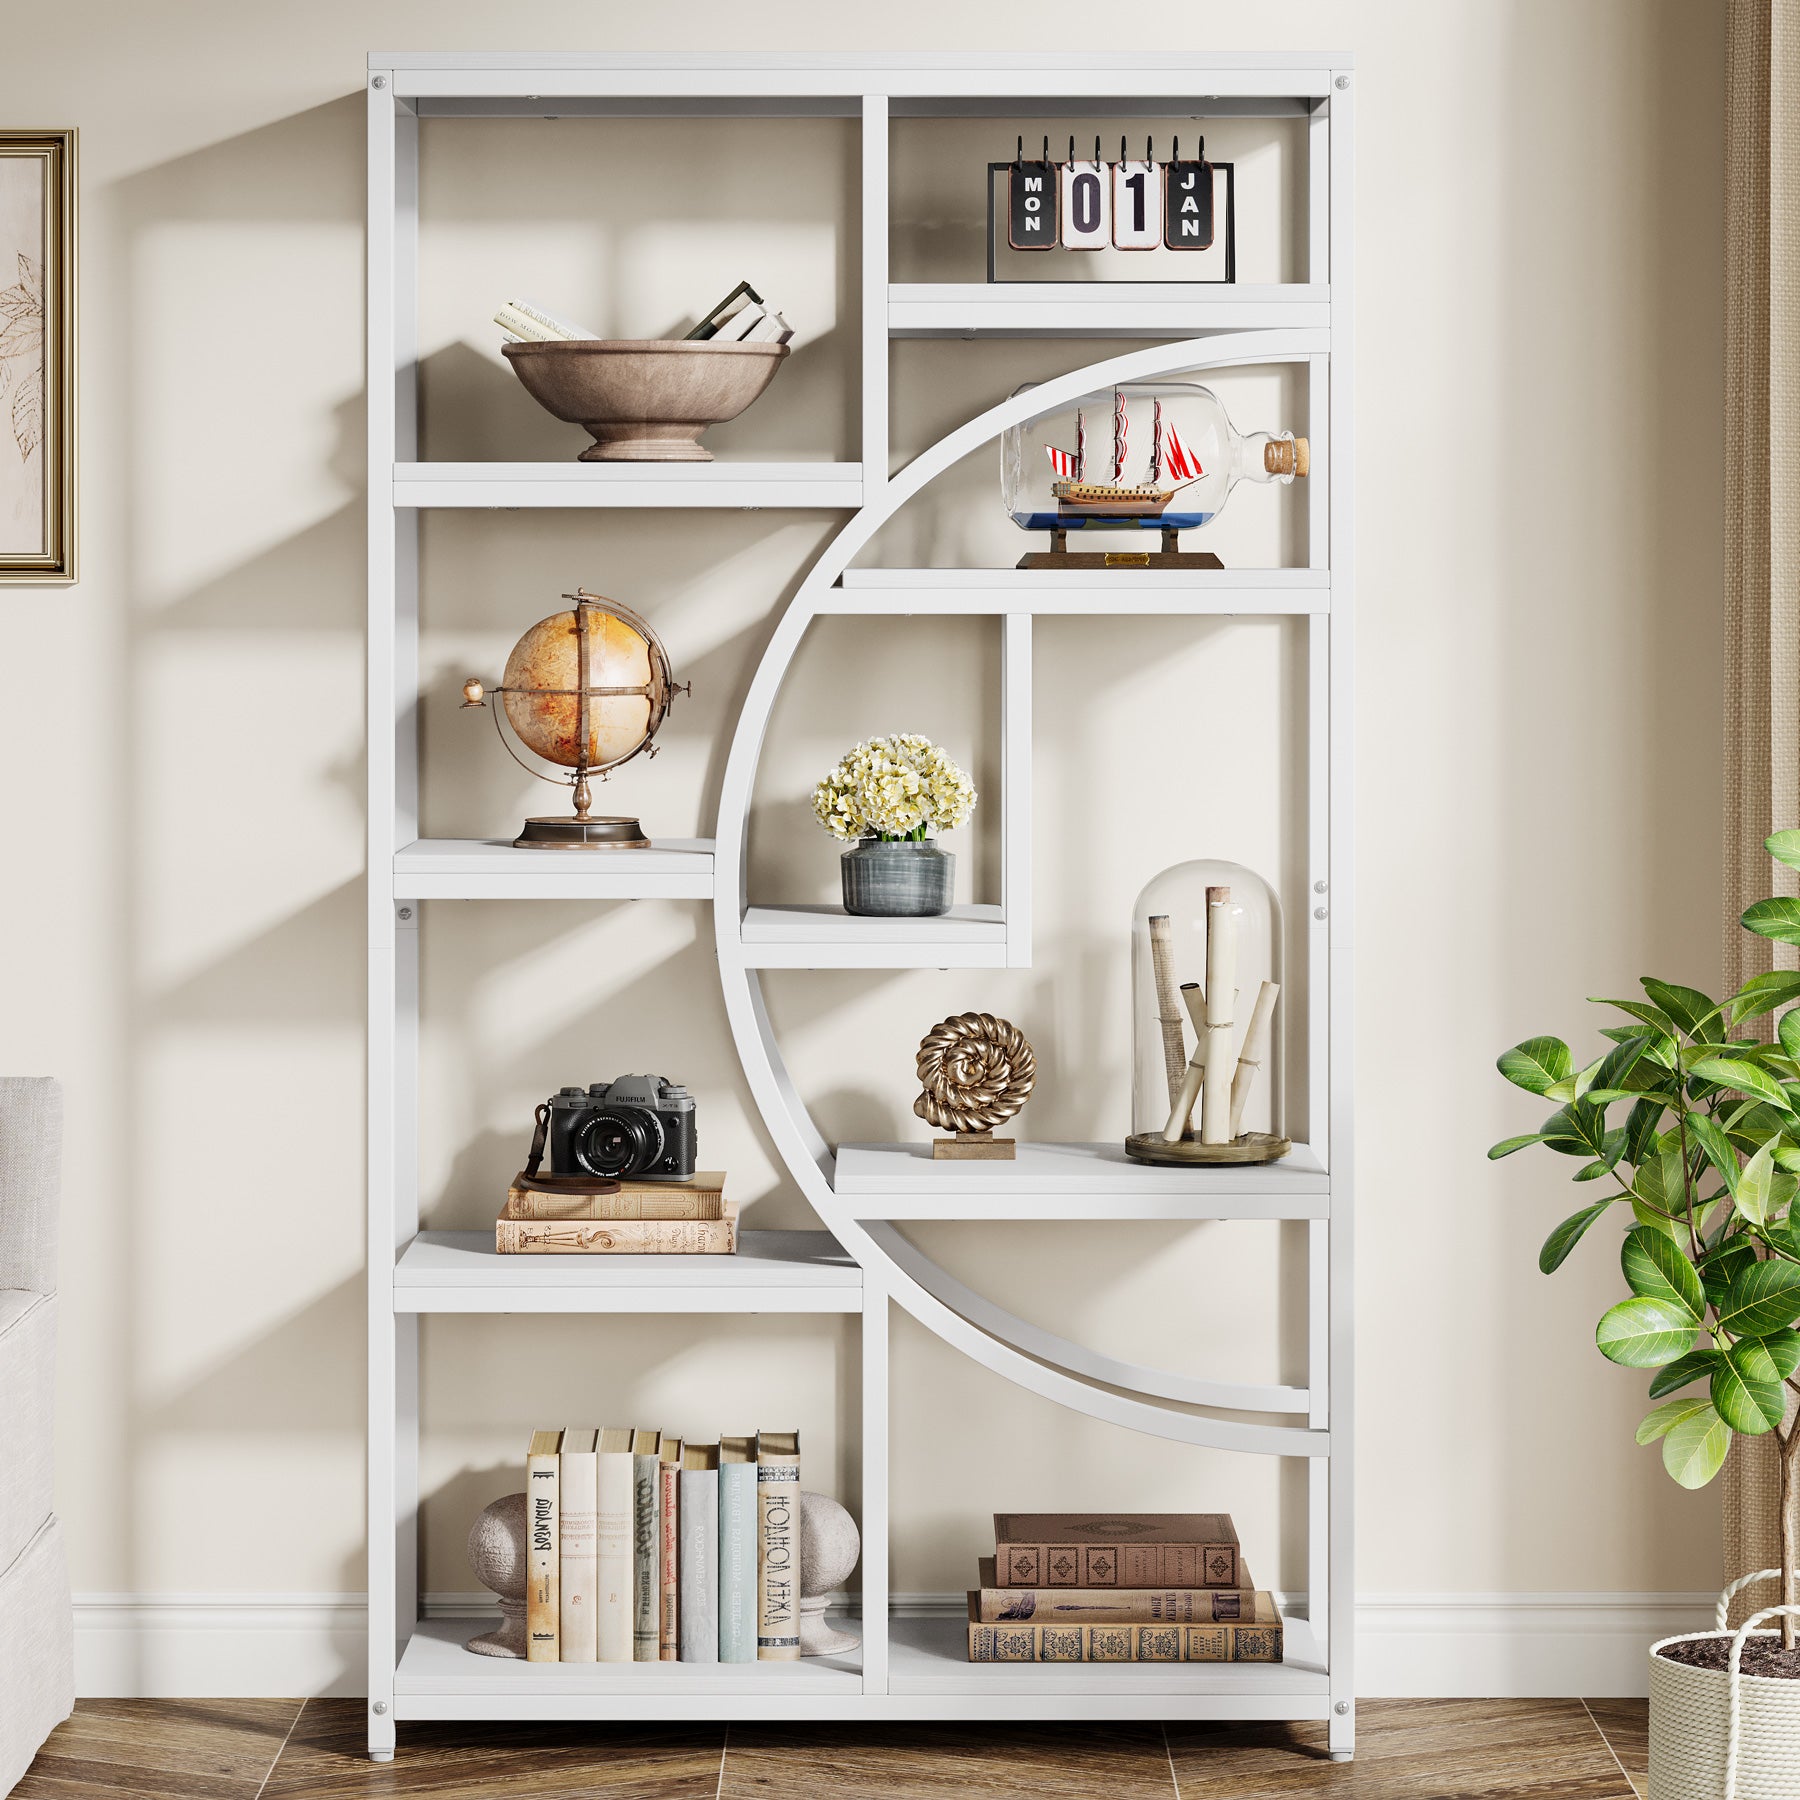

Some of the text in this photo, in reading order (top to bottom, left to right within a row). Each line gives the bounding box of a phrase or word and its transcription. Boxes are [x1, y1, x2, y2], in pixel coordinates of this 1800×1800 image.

[1024, 177, 1042, 231] MON
[1180, 172, 1199, 236] JAN
[616, 1095, 645, 1103] FUJIFILM
